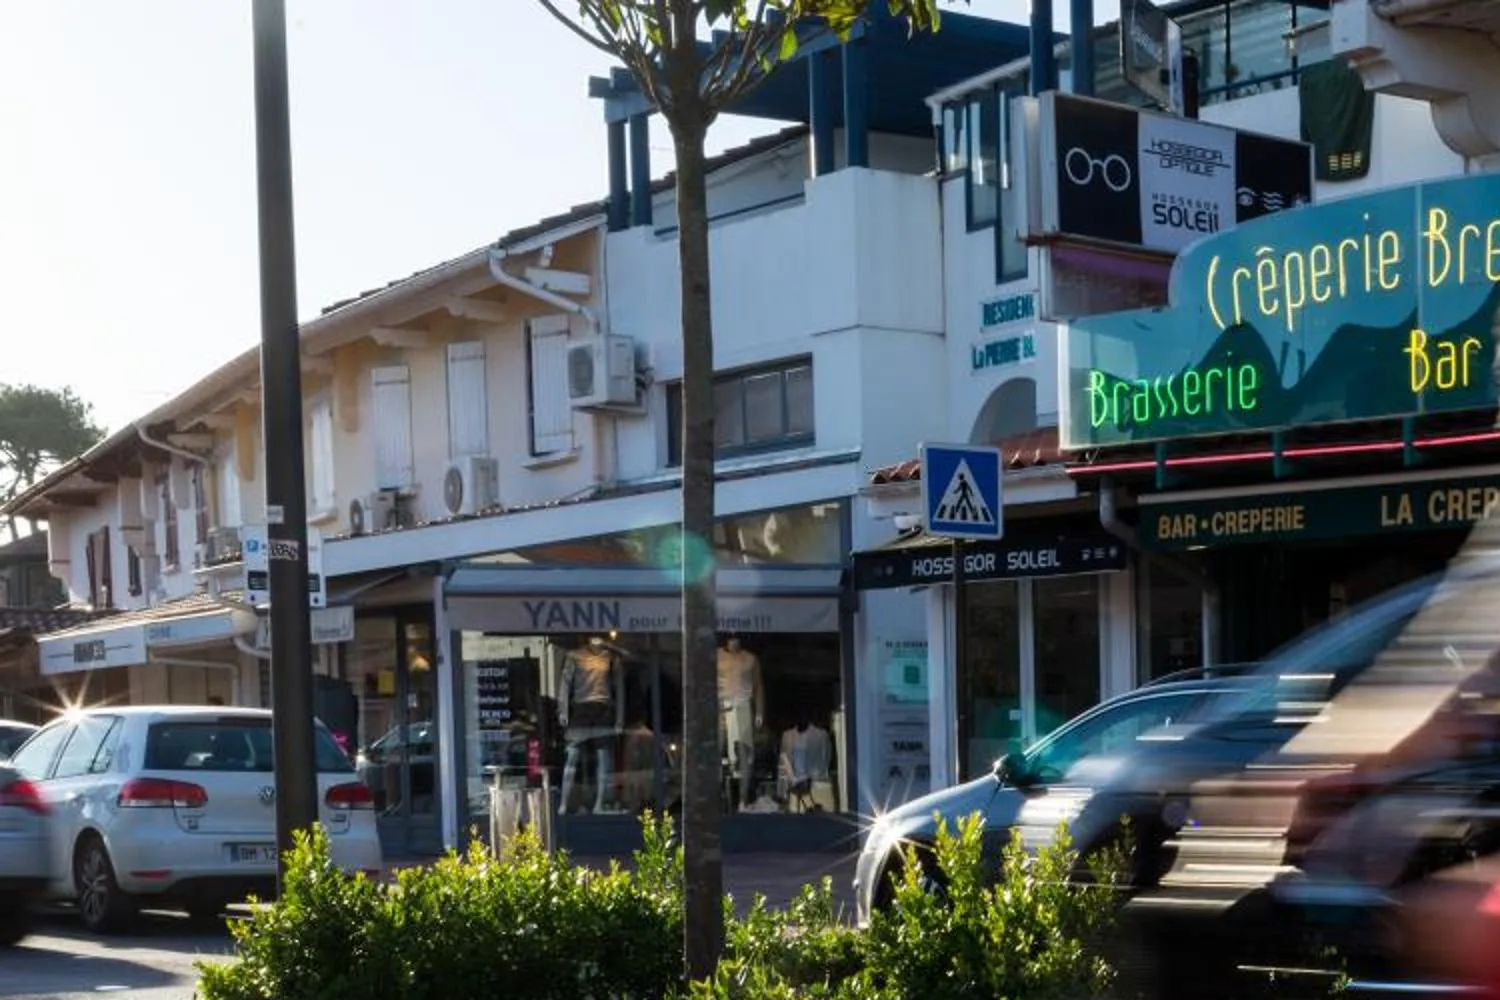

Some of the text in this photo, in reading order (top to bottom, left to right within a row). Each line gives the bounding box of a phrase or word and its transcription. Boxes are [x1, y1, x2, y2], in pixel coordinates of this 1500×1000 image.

[1206, 210, 1400, 333] Crêperie
[1403, 328, 1482, 394] Bar
[1085, 349, 1257, 429] Brasserie
[1159, 505, 1306, 540] BAR CREPERIE
[1381, 493, 1413, 527] LA
[912, 548, 1061, 577] HOSSGOR SOLEIL
[524, 600, 621, 630] YANN
